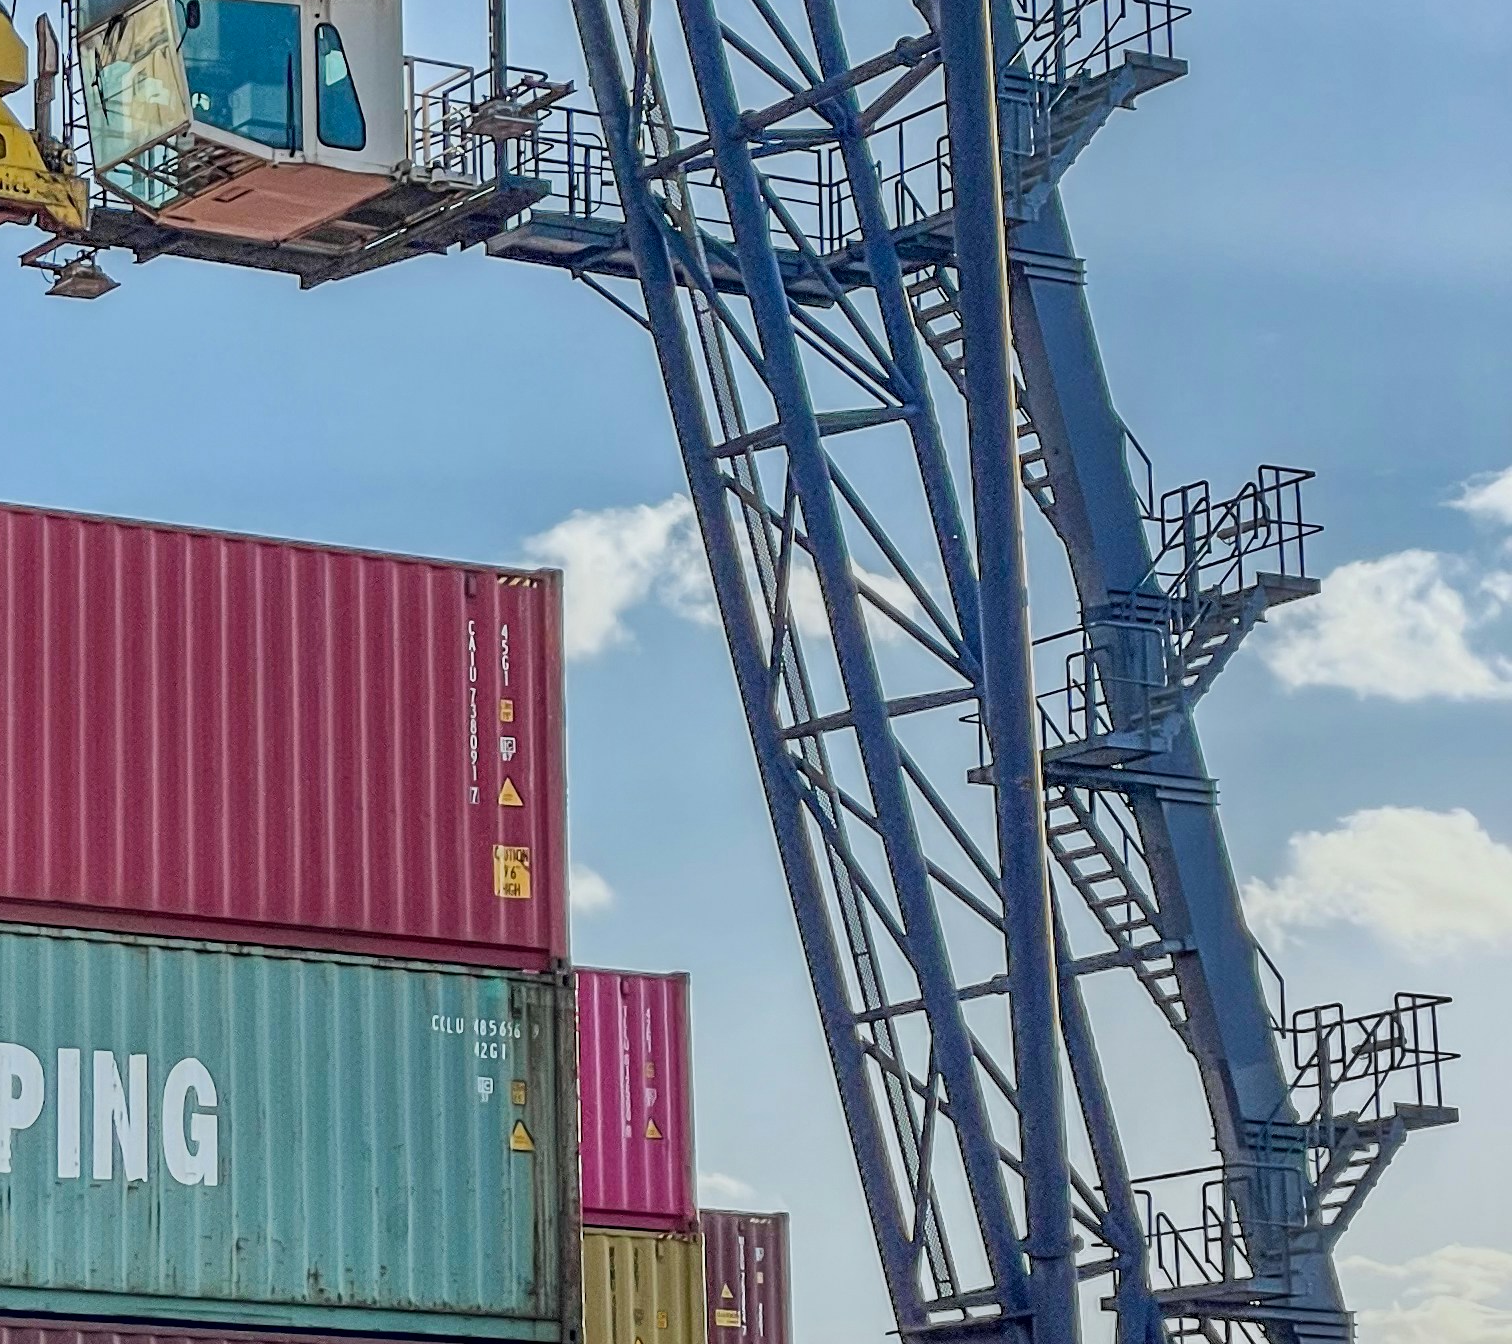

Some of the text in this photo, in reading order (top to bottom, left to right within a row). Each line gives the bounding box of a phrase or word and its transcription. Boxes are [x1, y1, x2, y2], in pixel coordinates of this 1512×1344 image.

[468, 620, 477, 683] CAIU
[501, 624, 510, 687] 45G1
[469, 787, 480, 805] 7
